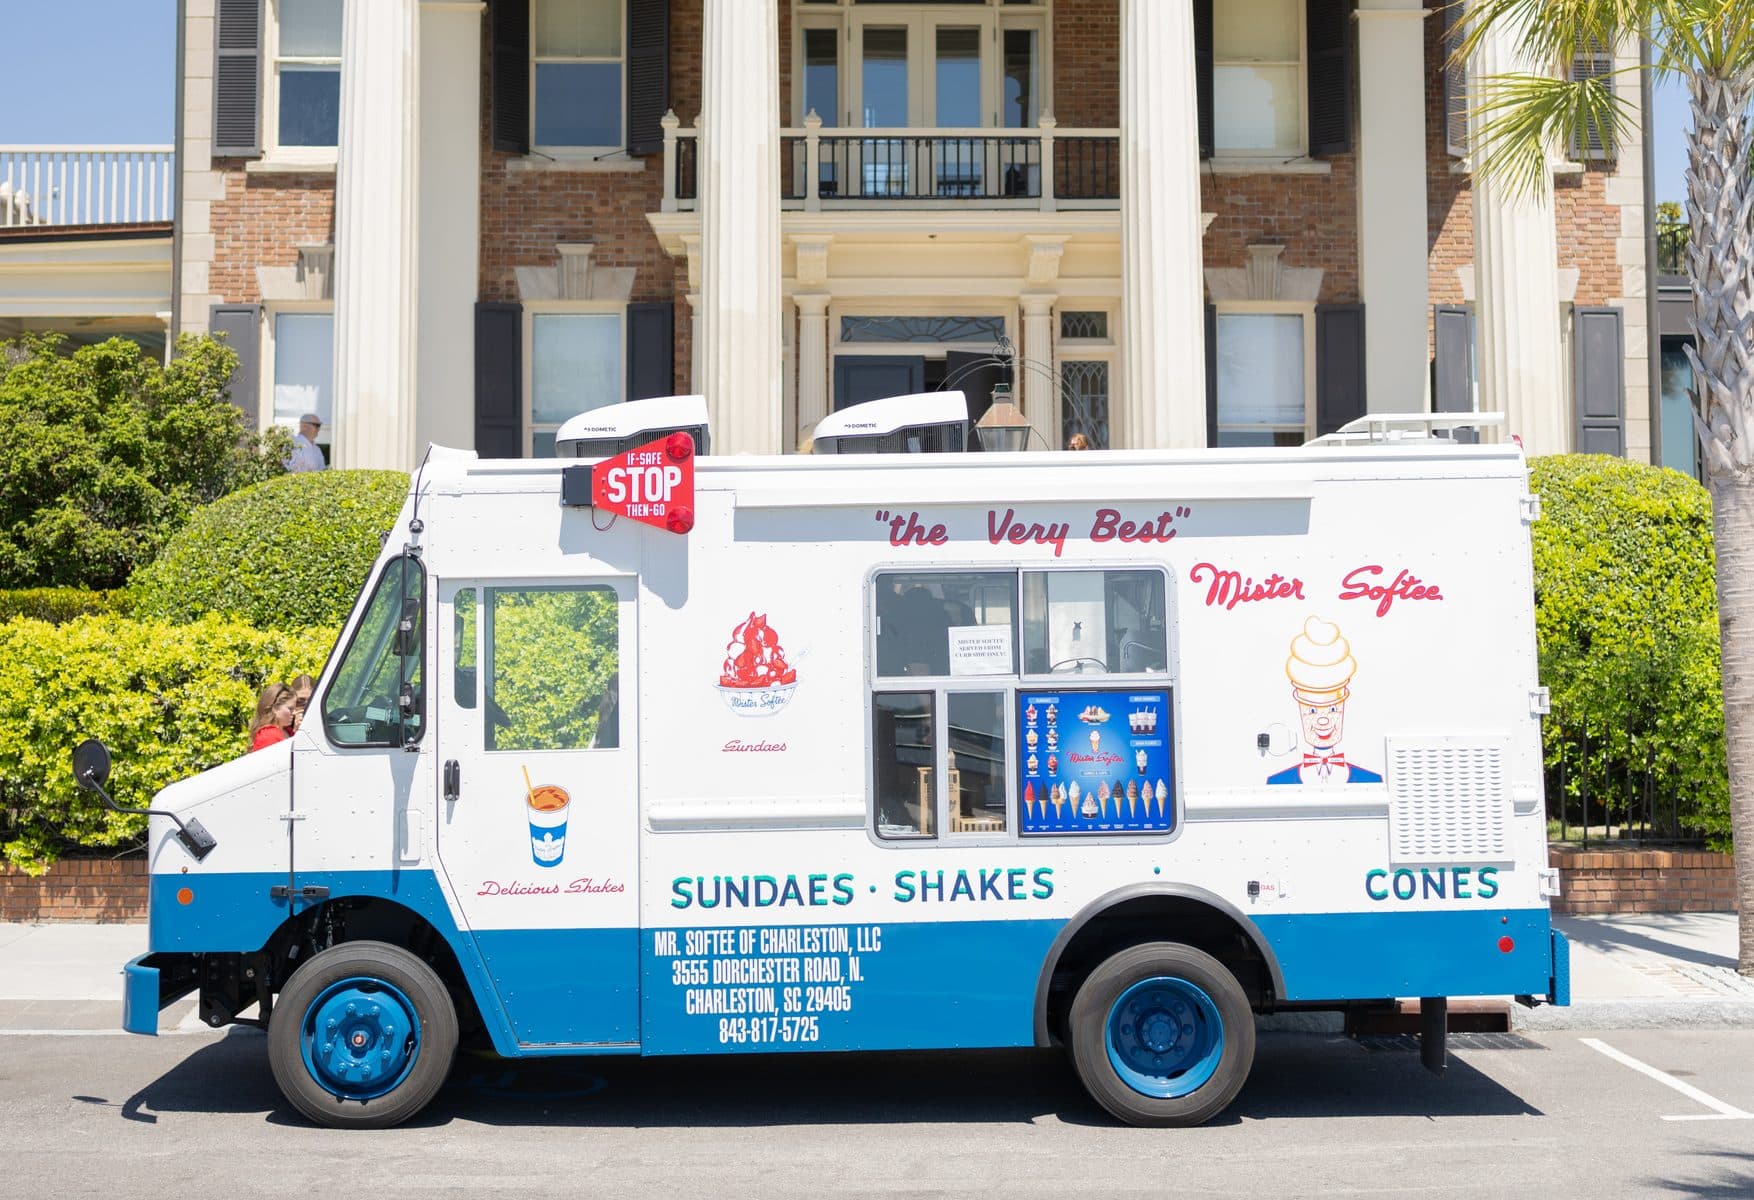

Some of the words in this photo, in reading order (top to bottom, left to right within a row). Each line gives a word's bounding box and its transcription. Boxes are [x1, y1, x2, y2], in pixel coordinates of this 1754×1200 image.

[627, 452, 662, 466] IF-SAFE
[607, 466, 682, 504] STOP
[626, 503, 665, 517] THEN-GO
[875, 510, 949, 546] "the
[988, 508, 1070, 558] Very
[1090, 506, 1191, 543] Best"
[1190, 562, 1305, 611] Mister
[1338, 565, 1443, 618] Softee
[731, 696, 757, 708] Mister
[722, 739, 787, 752] Sundaes
[477, 880, 560, 896] Delicious
[564, 877, 625, 894] Shakes
[671, 874, 855, 910] SUNDAES
[893, 867, 1054, 903] SHAKES
[1365, 866, 1499, 901] CONES
[654, 930, 681, 957] MR.
[685, 929, 737, 956] SOFTEE
[739, 928, 758, 955] OF
[760, 927, 854, 956] CHARLESTON,
[857, 926, 882, 953] LLC
[672, 959, 709, 986] 3555
[713, 957, 800, 985] DORCHESTER
[804, 956, 847, 987] ROAD,
[849, 957, 864, 982] N.
[685, 988, 780, 1017] CHARLESTON,
[783, 987, 802, 1013] SC
[806, 986, 851, 1012] 29405
[719, 1017, 819, 1044] 843-817-5725
